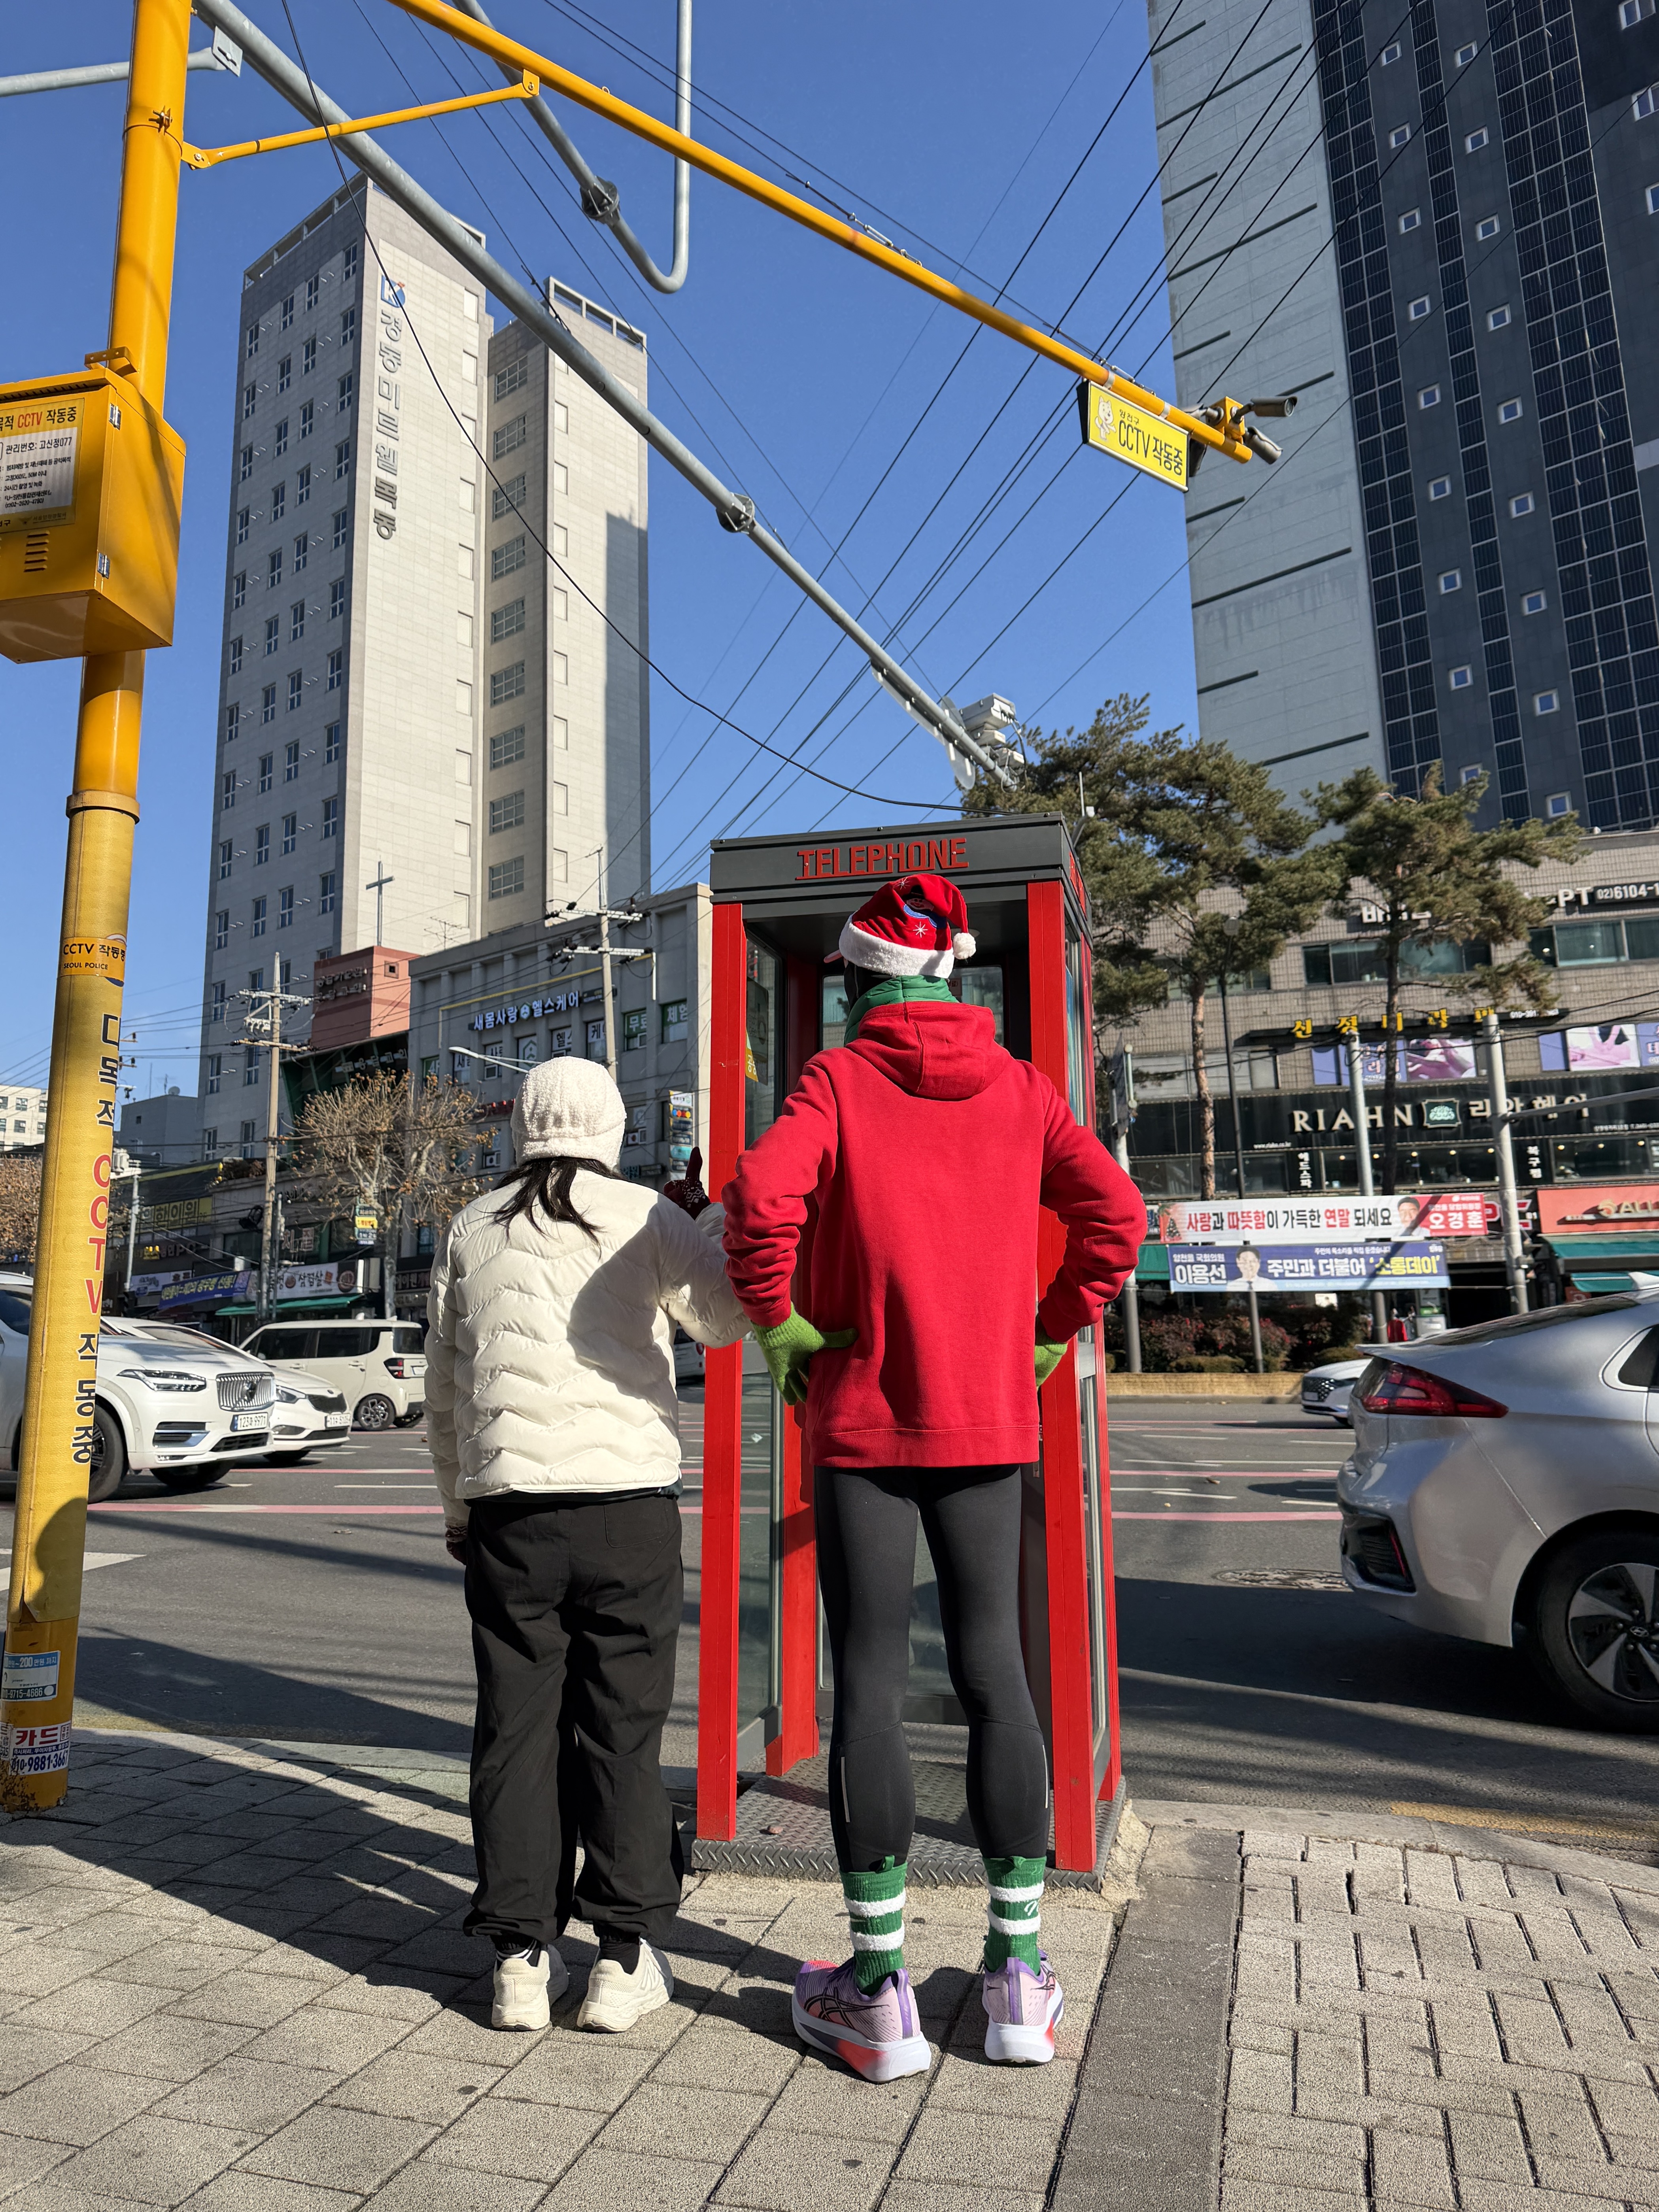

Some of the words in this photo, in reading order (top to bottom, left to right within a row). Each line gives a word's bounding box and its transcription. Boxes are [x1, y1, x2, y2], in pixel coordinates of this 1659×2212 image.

[18, 412, 43, 428] CCTV
[46, 406, 77, 424] 작동중
[1119, 409, 1139, 425] 양천구
[40, 437, 72, 450] 고신정077
[1119, 420, 1151, 459] CCTV
[1153, 436, 1183, 476] 작동중
[795, 837, 969, 880] TELEPHONE
[1557, 886, 1593, 908] PT
[63, 943, 94, 956] CCTV
[98, 943, 126, 962] 작동중
[85, 961, 108, 970] POLICE
[474, 1005, 518, 1031] 새몸사랑
[531, 990, 579, 1017] 헬스케어
[1293, 1103, 1414, 1133] RIAHN
[1187, 1211, 1224, 1232] 사랑과
[1227, 1209, 1279, 1230] 따뜻함이
[1282, 1208, 1321, 1229] 가득한
[1324, 1208, 1350, 1228] 연말
[1354, 1207, 1392, 1227] 되세요
[1429, 1211, 1483, 1230] 오경훈
[83, 1154, 111, 1315] CCTV
[1196, 1252, 1225, 1262] 국회의원
[1268, 1258, 1315, 1278] 주민과
[1318, 1257, 1367, 1277] 더불어
[1175, 1264, 1227, 1285] 이용선
[15, 1727, 59, 1747] 카드
